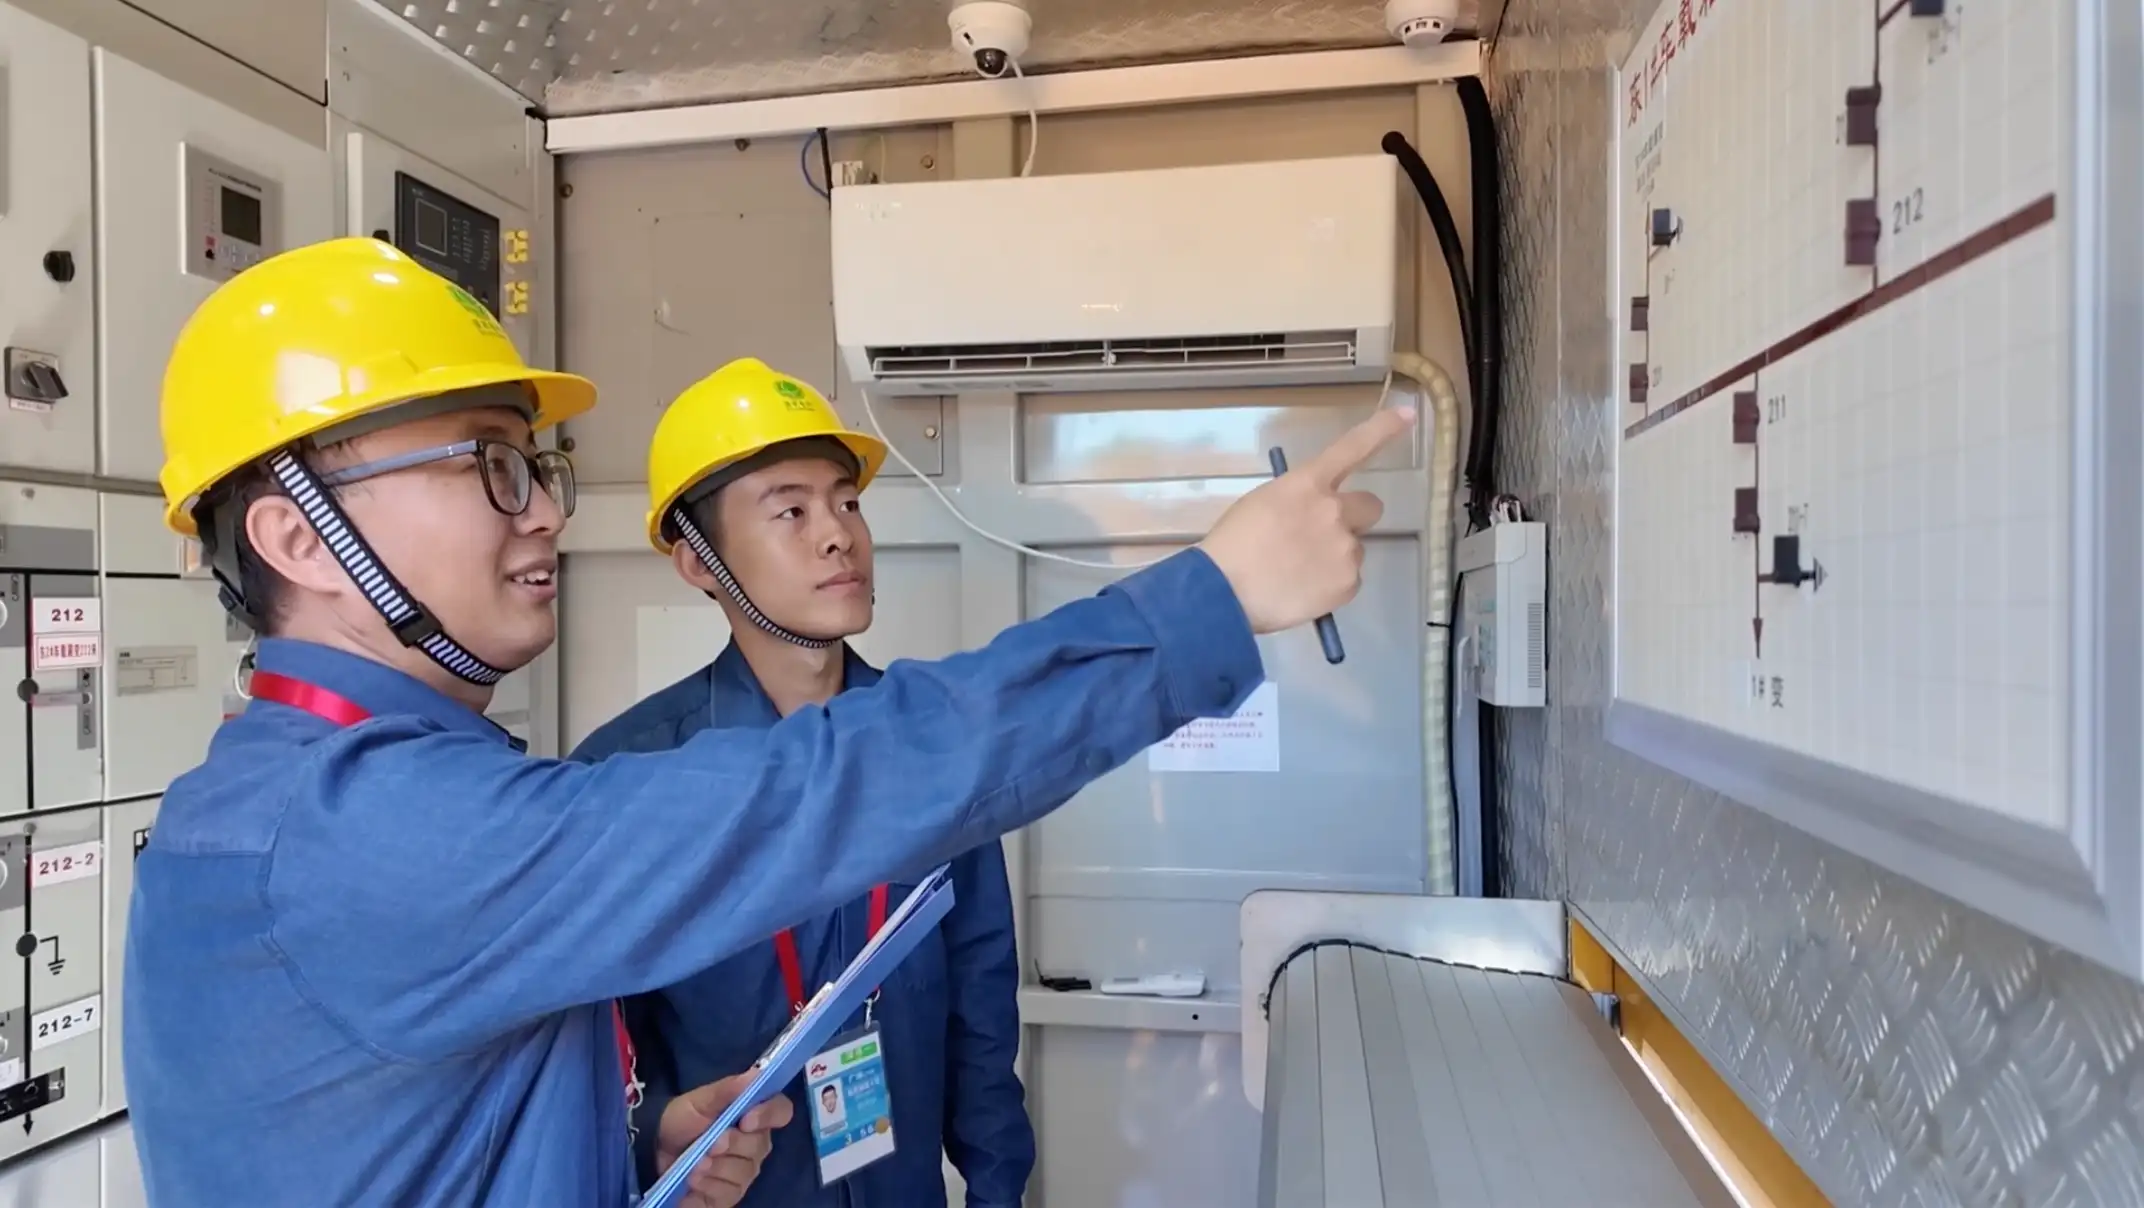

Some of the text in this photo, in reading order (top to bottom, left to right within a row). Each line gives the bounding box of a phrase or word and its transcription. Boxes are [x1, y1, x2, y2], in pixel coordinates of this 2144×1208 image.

[1893, 186, 1924, 235] 212
[1767, 394, 1787, 425] 211
[51, 608, 84, 622] 212
[39, 852, 95, 876] 212-2
[38, 1007, 94, 1039] 212-7
